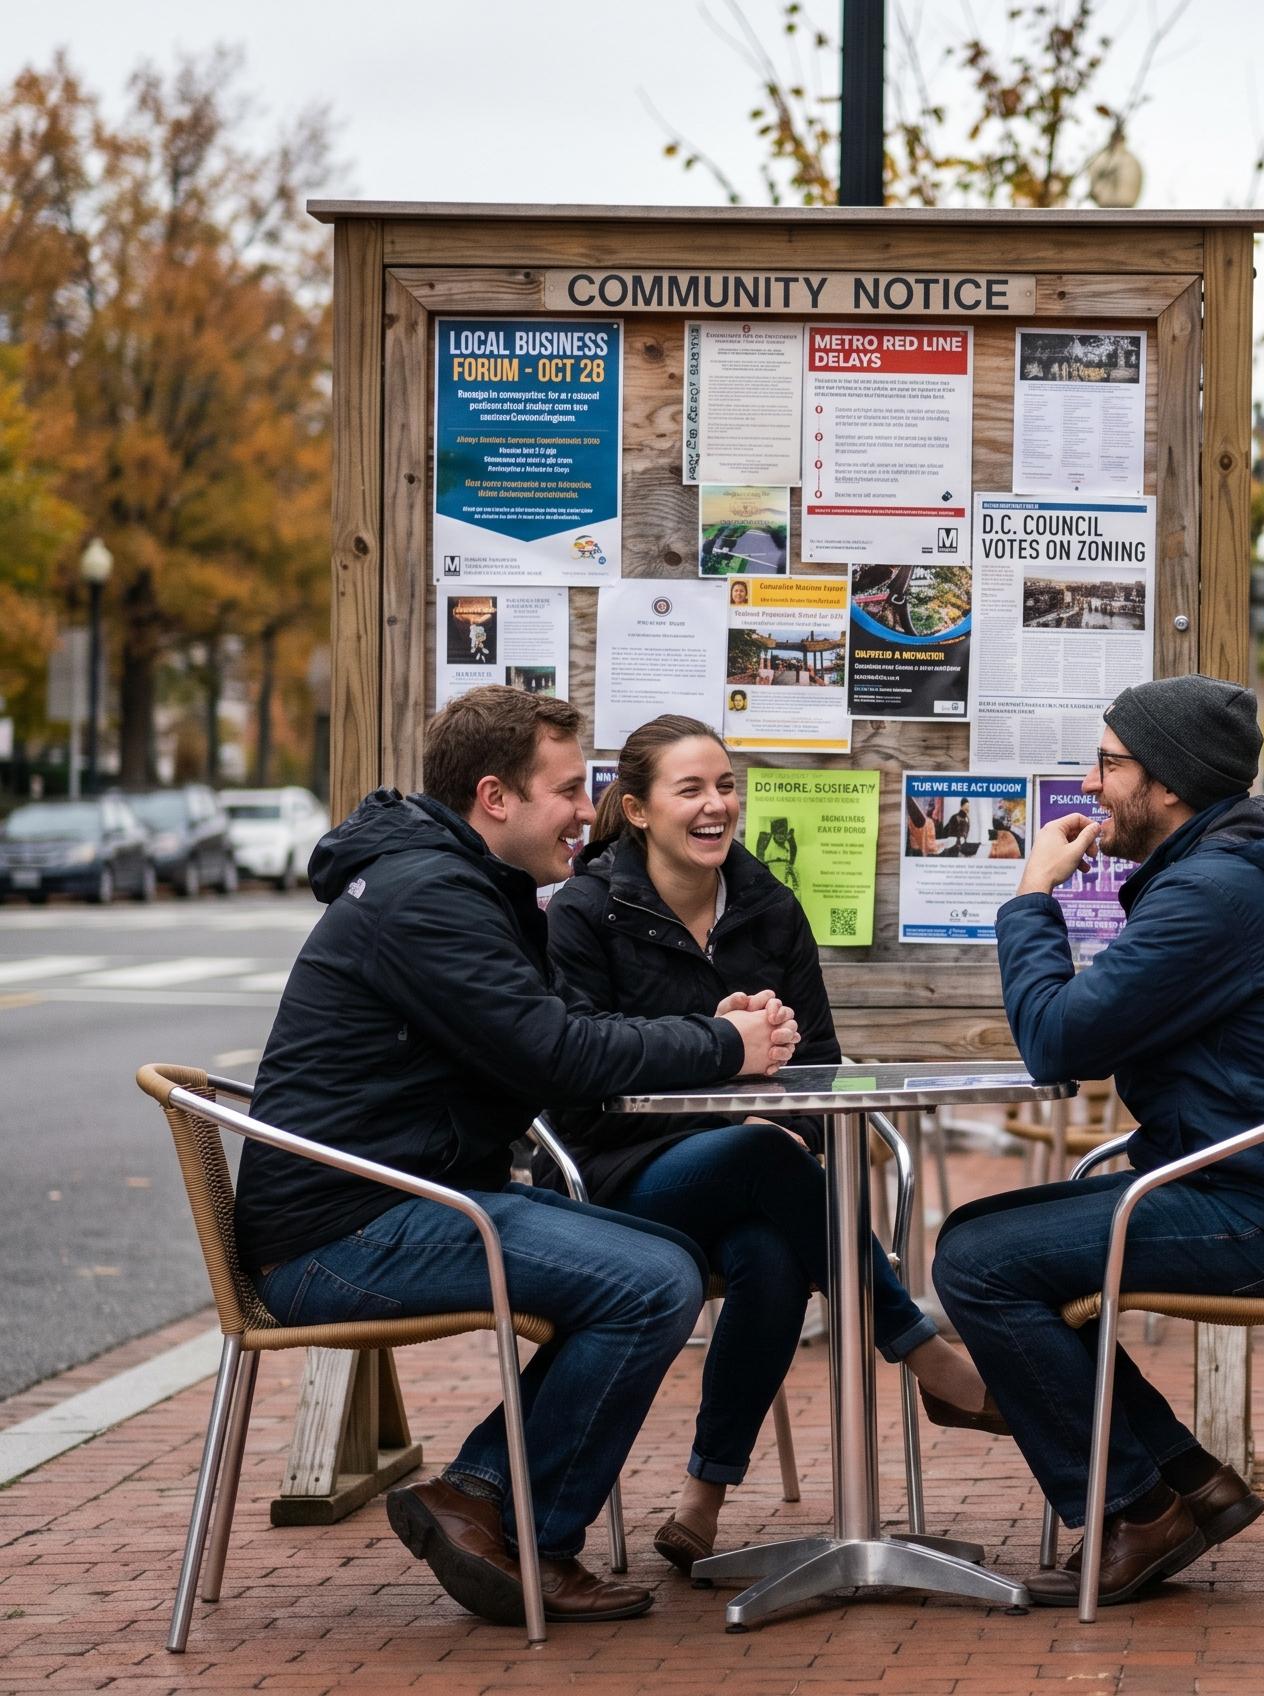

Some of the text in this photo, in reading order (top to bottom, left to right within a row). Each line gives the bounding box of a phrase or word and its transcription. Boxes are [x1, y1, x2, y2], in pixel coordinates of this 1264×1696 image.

[567, 274, 1009, 311] COMMUNITY NOTICE
[450, 331, 608, 356] LOCAL BUSINESS
[815, 335, 962, 351] METRO RED LINE
[815, 352, 881, 367] DELAYS
[453, 358, 518, 381] FORUM
[538, 359, 574, 382] OCT
[580, 359, 604, 382] 28
[983, 514, 1103, 536] D.C. COUNCIL
[938, 529, 957, 548] M
[982, 539, 1146, 562] VOTES ON ZONING
[445, 556, 460, 571] M
[970, 783, 988, 791] ACT
